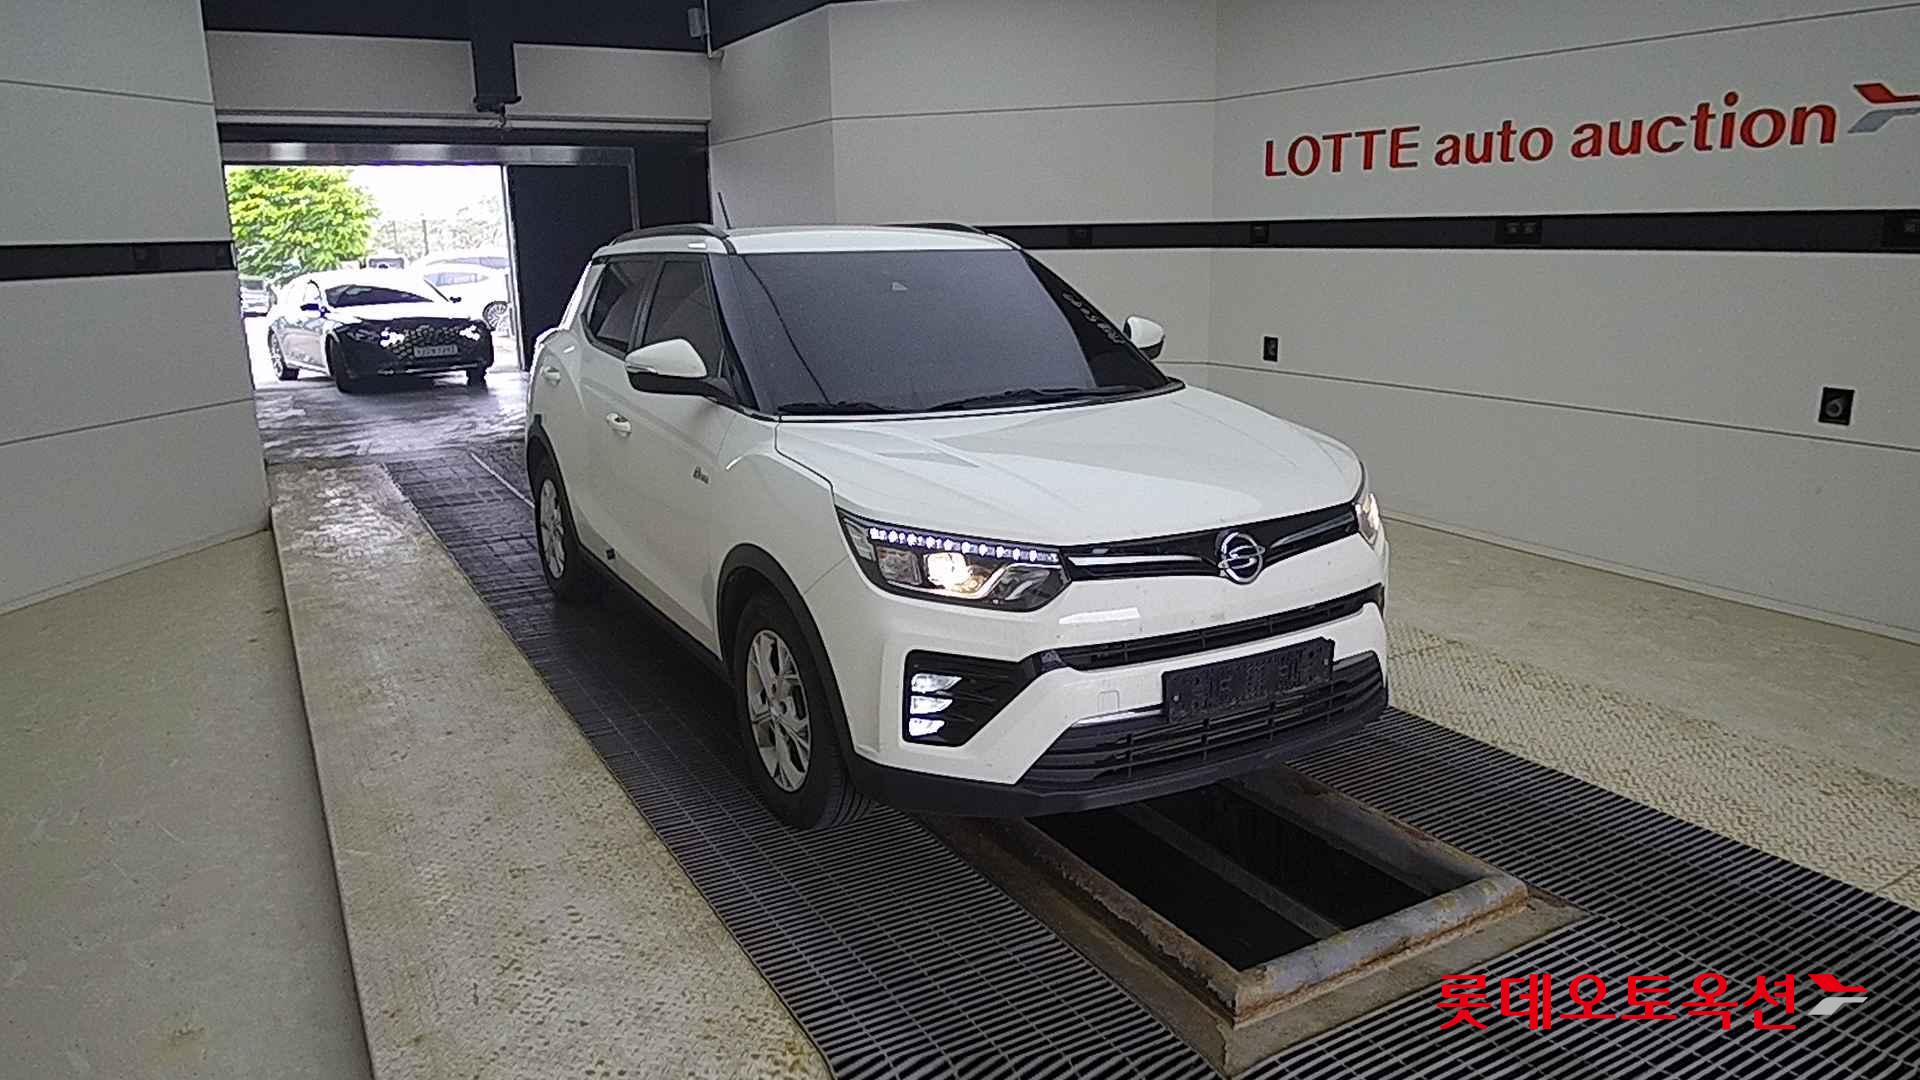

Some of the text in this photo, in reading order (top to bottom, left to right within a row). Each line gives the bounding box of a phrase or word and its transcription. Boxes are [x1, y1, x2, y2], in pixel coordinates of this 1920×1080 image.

[1265, 92, 1837, 177] LOTTE auto auction
